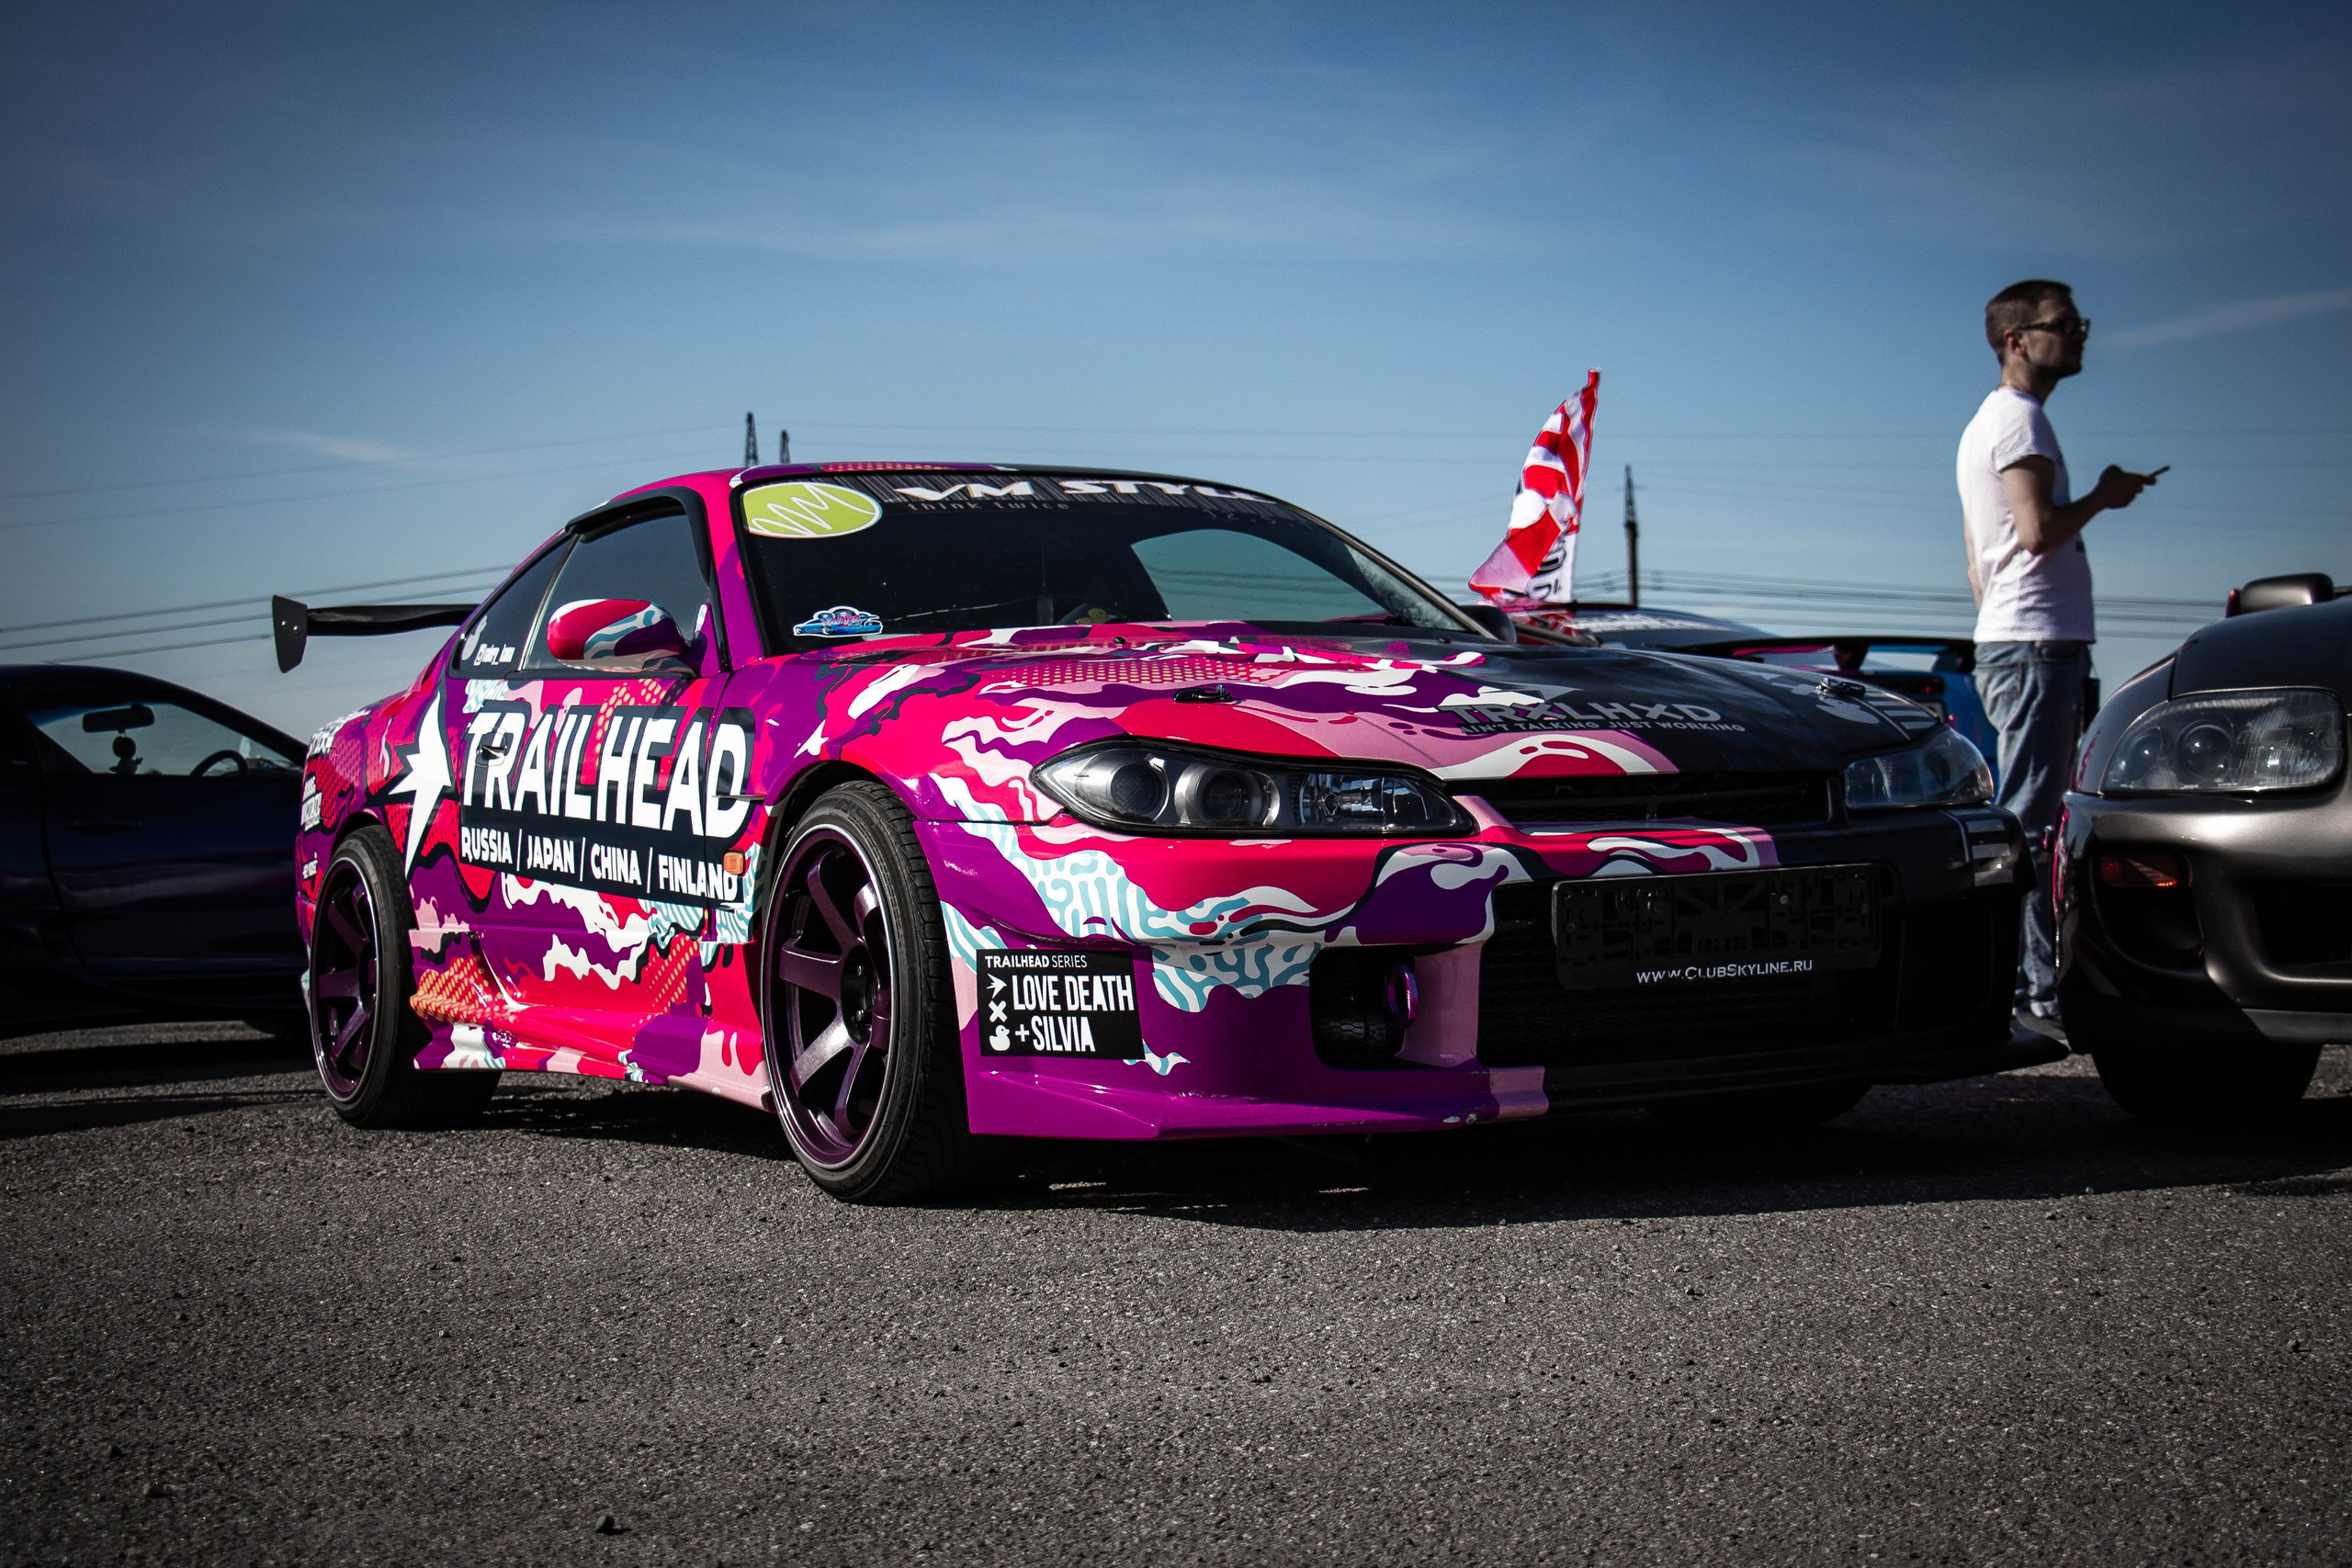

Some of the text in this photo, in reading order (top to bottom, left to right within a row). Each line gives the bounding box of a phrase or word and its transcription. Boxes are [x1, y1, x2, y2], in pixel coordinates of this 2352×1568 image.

[907, 502, 1070, 512] think twice
[1437, 702, 1722, 723] TRXLHXD
[1460, 720, 1747, 735] AIN'T TALKING JUST WORKING
[463, 712, 752, 839] TRAILHEAD
[461, 826, 514, 865] RUSSIA
[526, 834, 575, 874] JAPAN
[591, 842, 642, 886] CHINA
[658, 853, 739, 902] FINLAND
[985, 954, 1088, 969] TRAILHEAD SERIES
[1012, 974, 1136, 1012] LOVE DEATH
